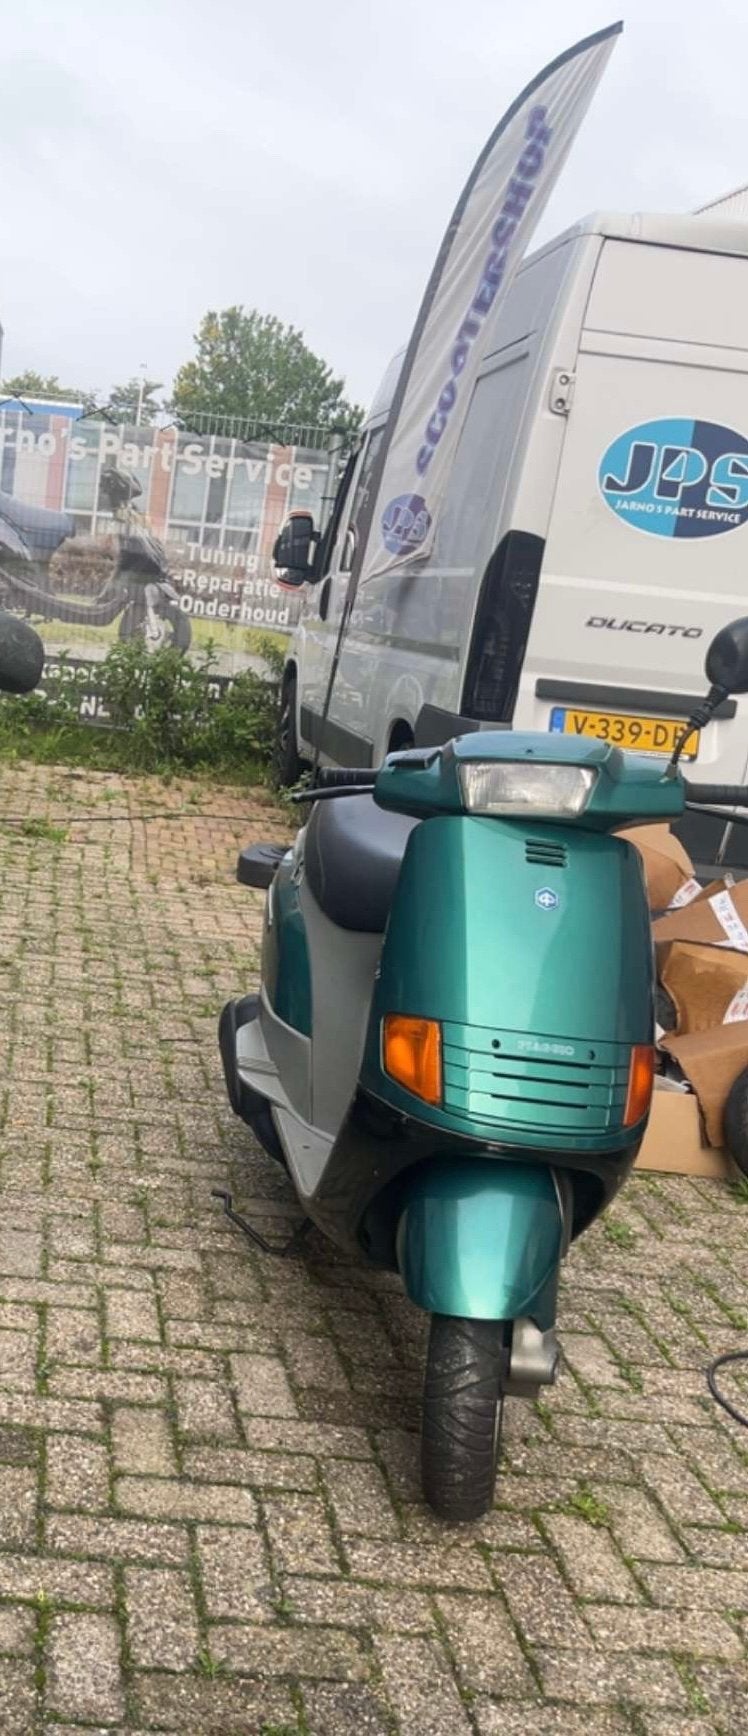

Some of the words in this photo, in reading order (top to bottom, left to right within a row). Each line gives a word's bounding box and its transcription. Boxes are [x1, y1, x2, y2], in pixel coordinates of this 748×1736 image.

[100, 432, 172, 472] Part
[182, 444, 313, 489] Service
[602, 441, 748, 508] JPS
[664, 505, 697, 518] PART
[697, 509, 741, 524] SERVICE
[585, 616, 703, 639] DUCATO
